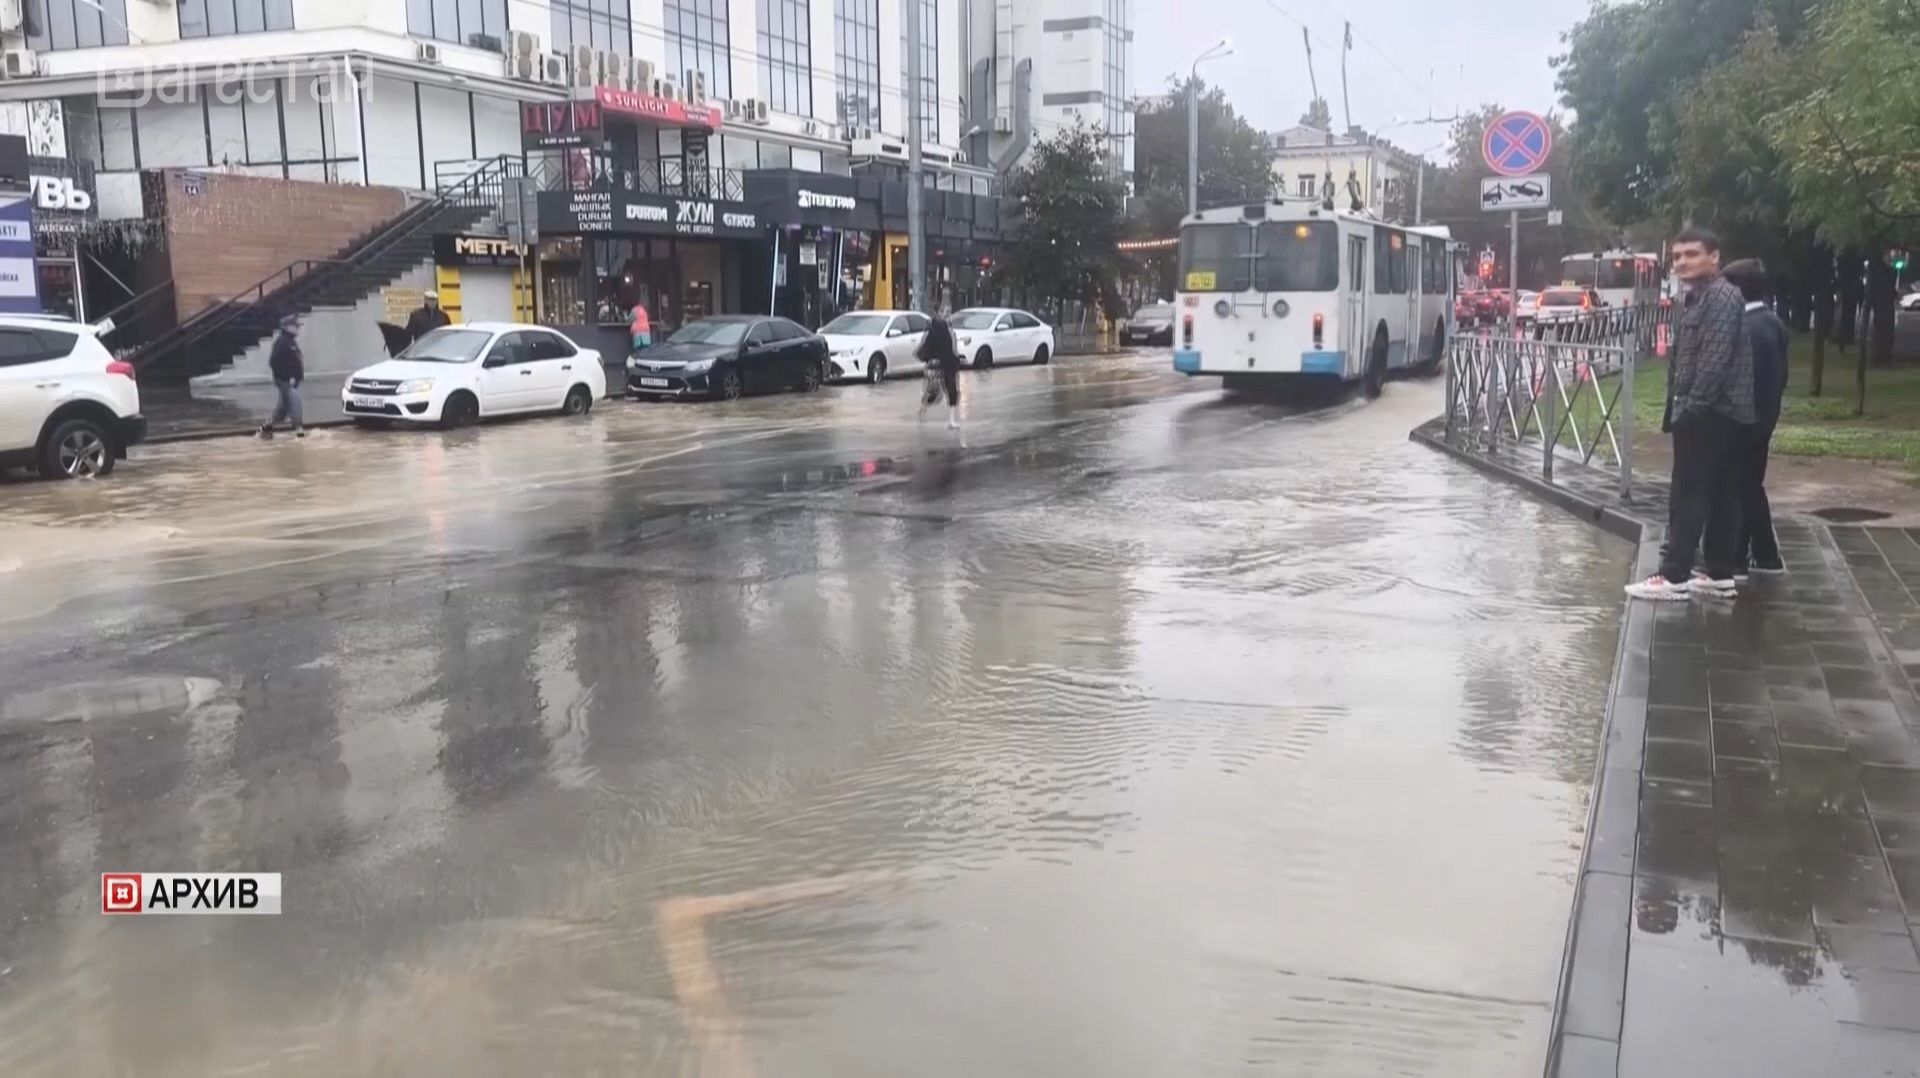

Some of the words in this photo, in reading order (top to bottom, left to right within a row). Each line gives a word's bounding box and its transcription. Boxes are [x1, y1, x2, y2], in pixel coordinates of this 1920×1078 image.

[616, 94, 671, 114] SUNLIGHT
[524, 103, 599, 133] ЦУМ
[574, 193, 611, 202] МАНГАЛ
[569, 203, 612, 212] ШАШЛЫК
[626, 204, 668, 221] DURUM
[676, 200, 714, 224] ЖУМ
[578, 212, 612, 221] DURUM
[723, 212, 756, 228] GYROS
[579, 222, 612, 231] DONER
